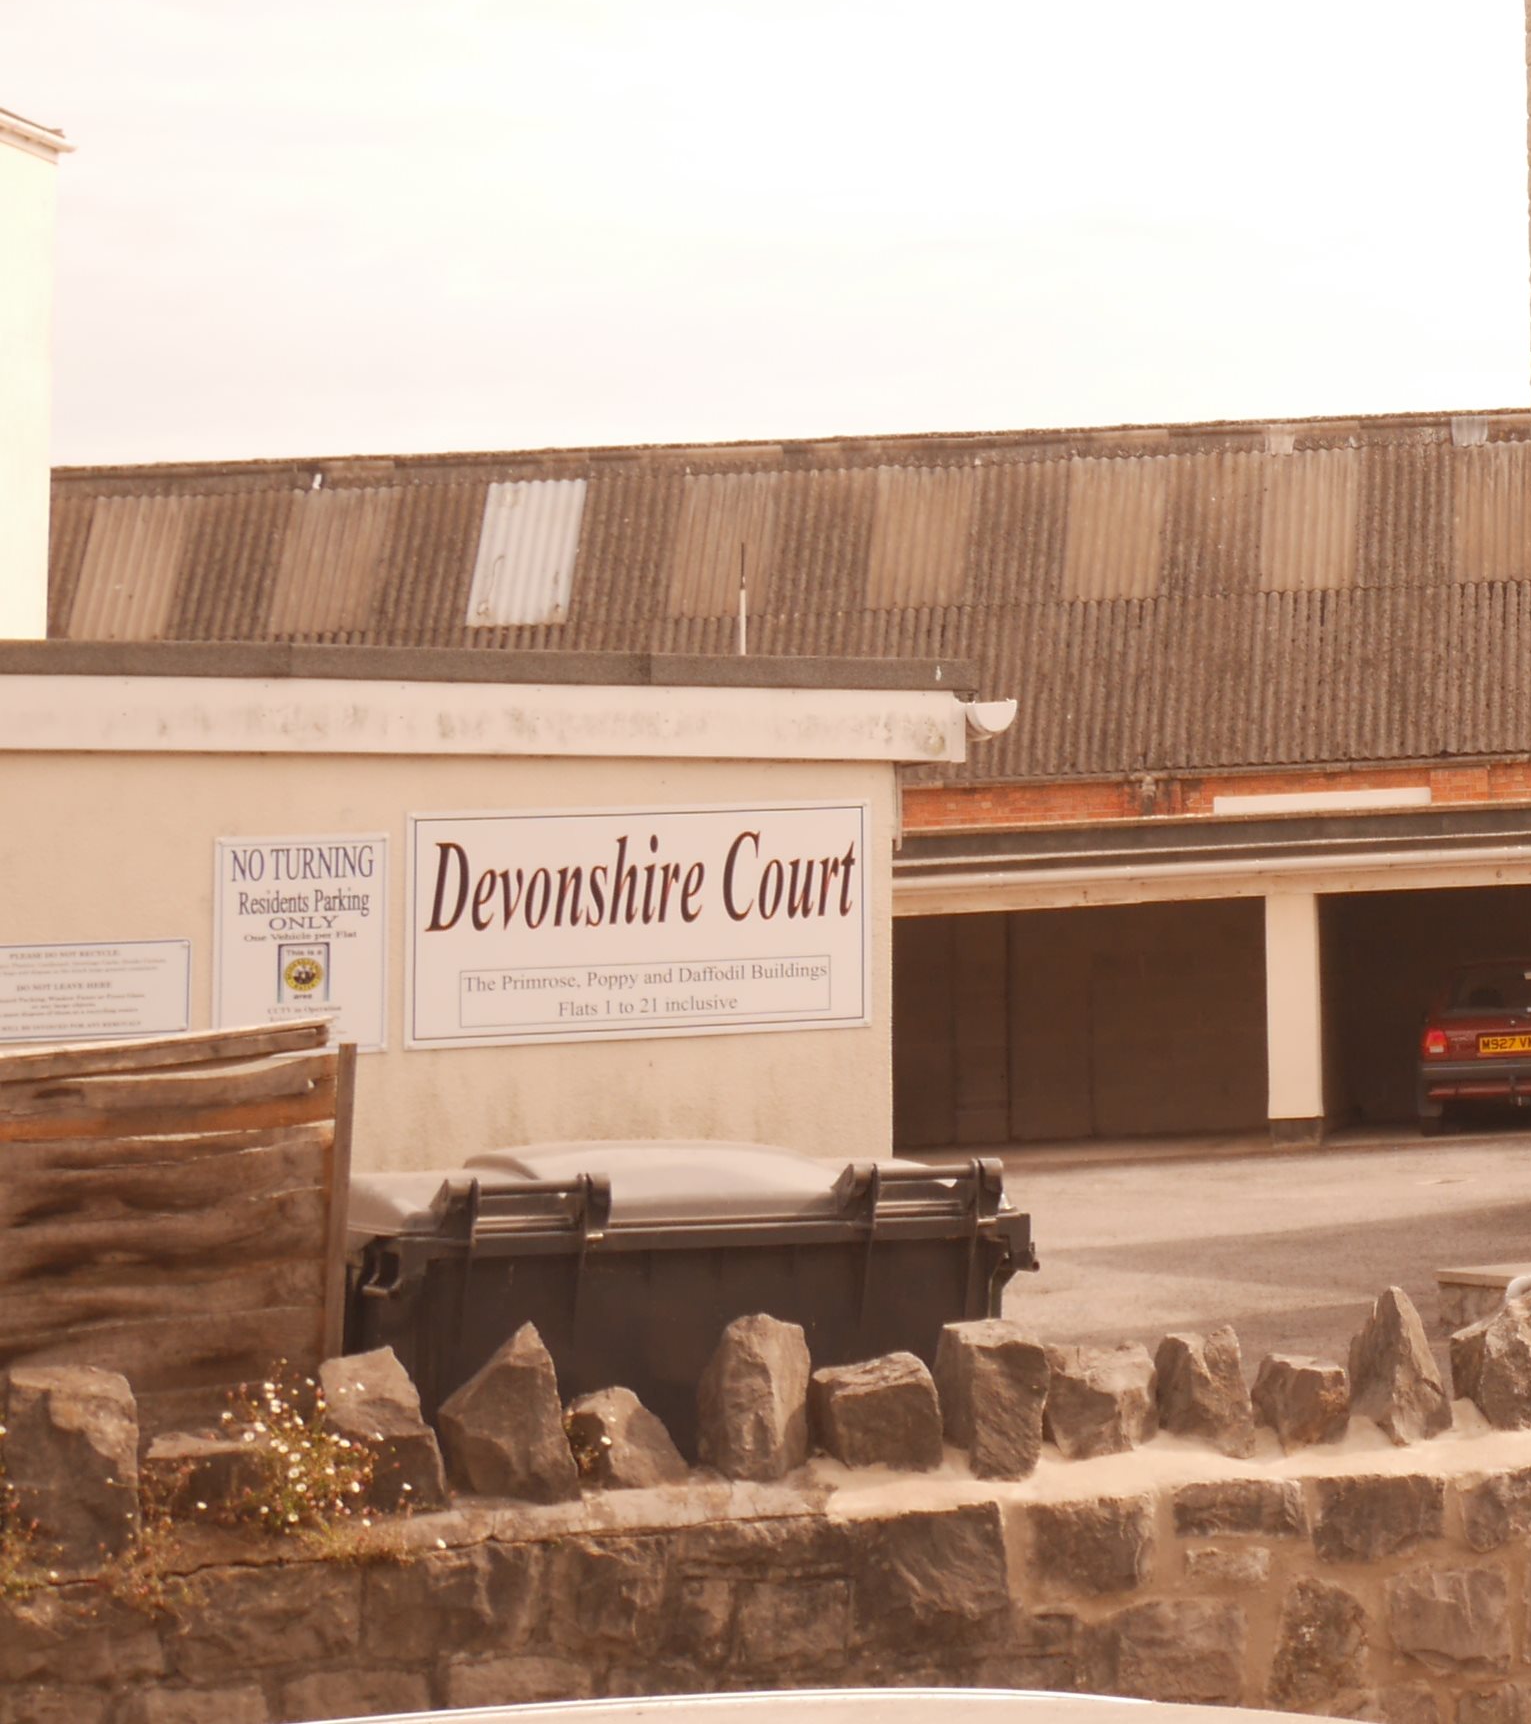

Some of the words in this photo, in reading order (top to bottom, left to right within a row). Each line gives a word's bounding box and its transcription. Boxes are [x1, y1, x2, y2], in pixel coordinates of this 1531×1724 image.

[231, 849, 265, 882] NO
[270, 845, 374, 880] TURNING
[424, 834, 705, 932] Devonshire
[722, 830, 856, 922] Court
[238, 889, 309, 915] Residents
[314, 887, 370, 917] Parking
[243, 934, 267, 942] One
[270, 932, 311, 941] Vehicle
[314, 933, 332, 942] per
[336, 930, 357, 939] Flat
[268, 915, 339, 931] ONLY
[464, 976, 496, 993] The
[586, 971, 637, 990] Poppy
[643, 968, 673, 985] and
[678, 965, 746, 983] Daffodil
[750, 962, 828, 982] Buildings
[558, 1000, 598, 1017] Flats
[604, 999, 611, 1014] 1
[618, 1000, 635, 1014] to
[639, 997, 658, 1013] 21
[665, 995, 738, 1012] inclusive
[1482, 1037, 1516, 1050] M927
